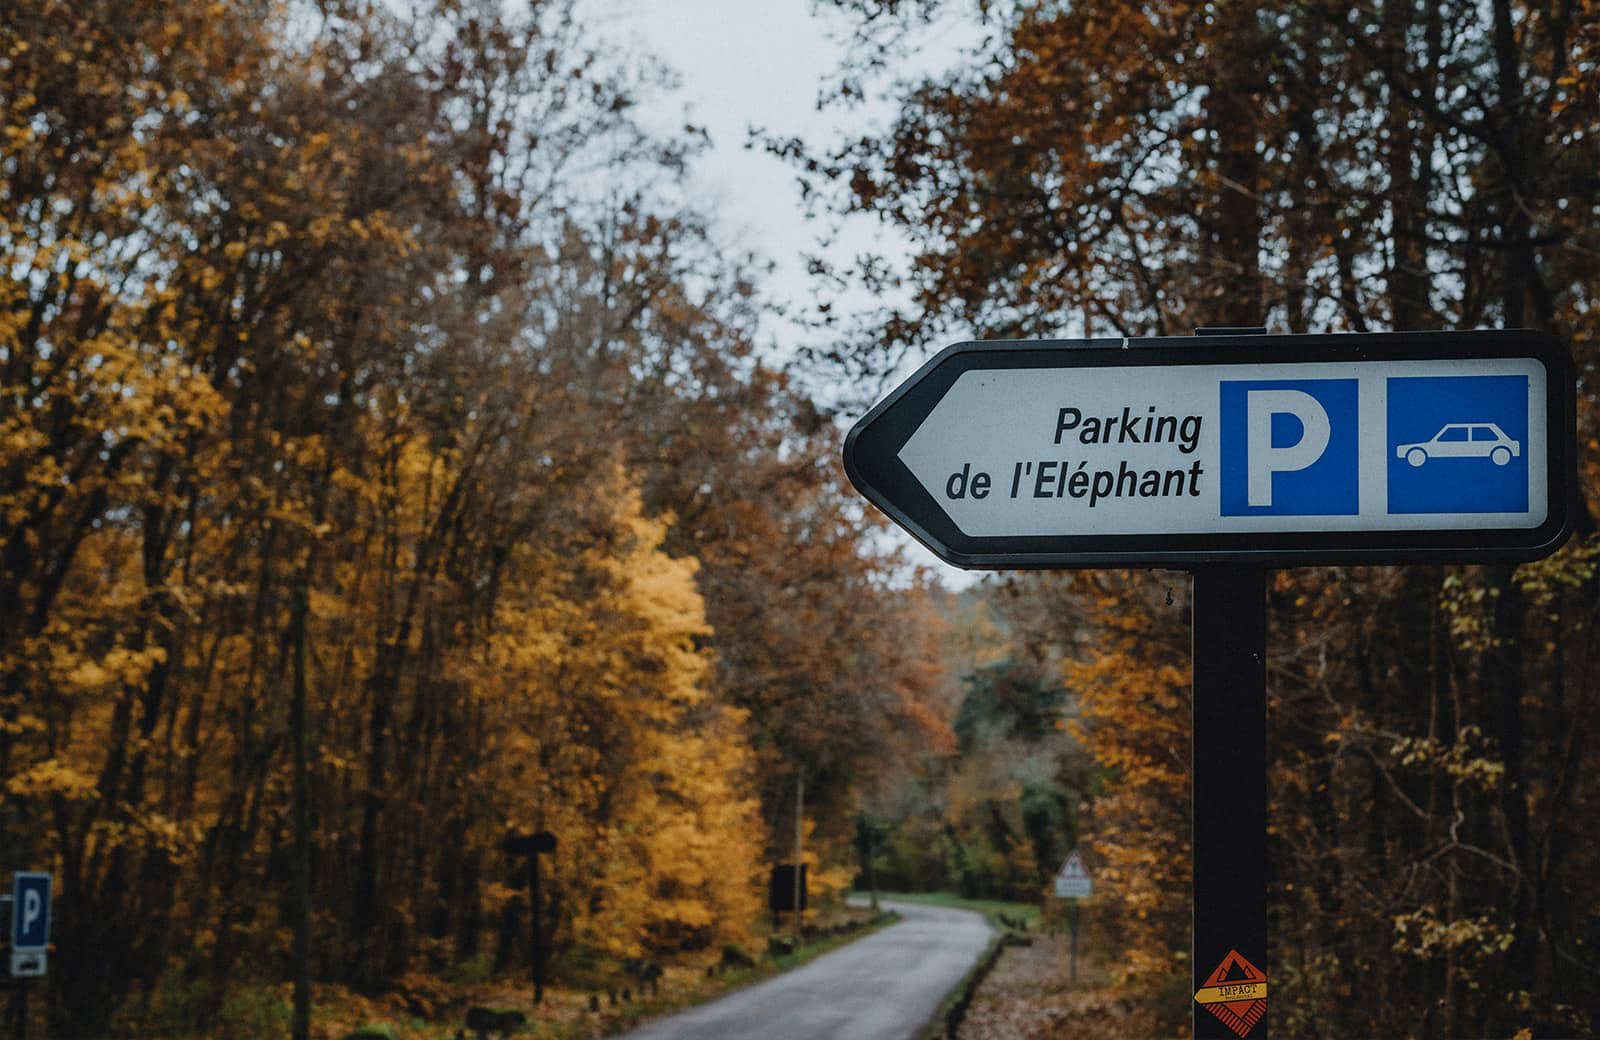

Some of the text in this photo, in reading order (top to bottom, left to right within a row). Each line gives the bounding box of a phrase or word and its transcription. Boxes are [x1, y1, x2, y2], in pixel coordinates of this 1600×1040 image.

[1054, 406, 1203, 454] Parking
[1247, 389, 1331, 506] P
[946, 460, 1204, 508] de l'Eléphant
[23, 889, 41, 934] P
[1218, 984, 1257, 997] IMPACT
